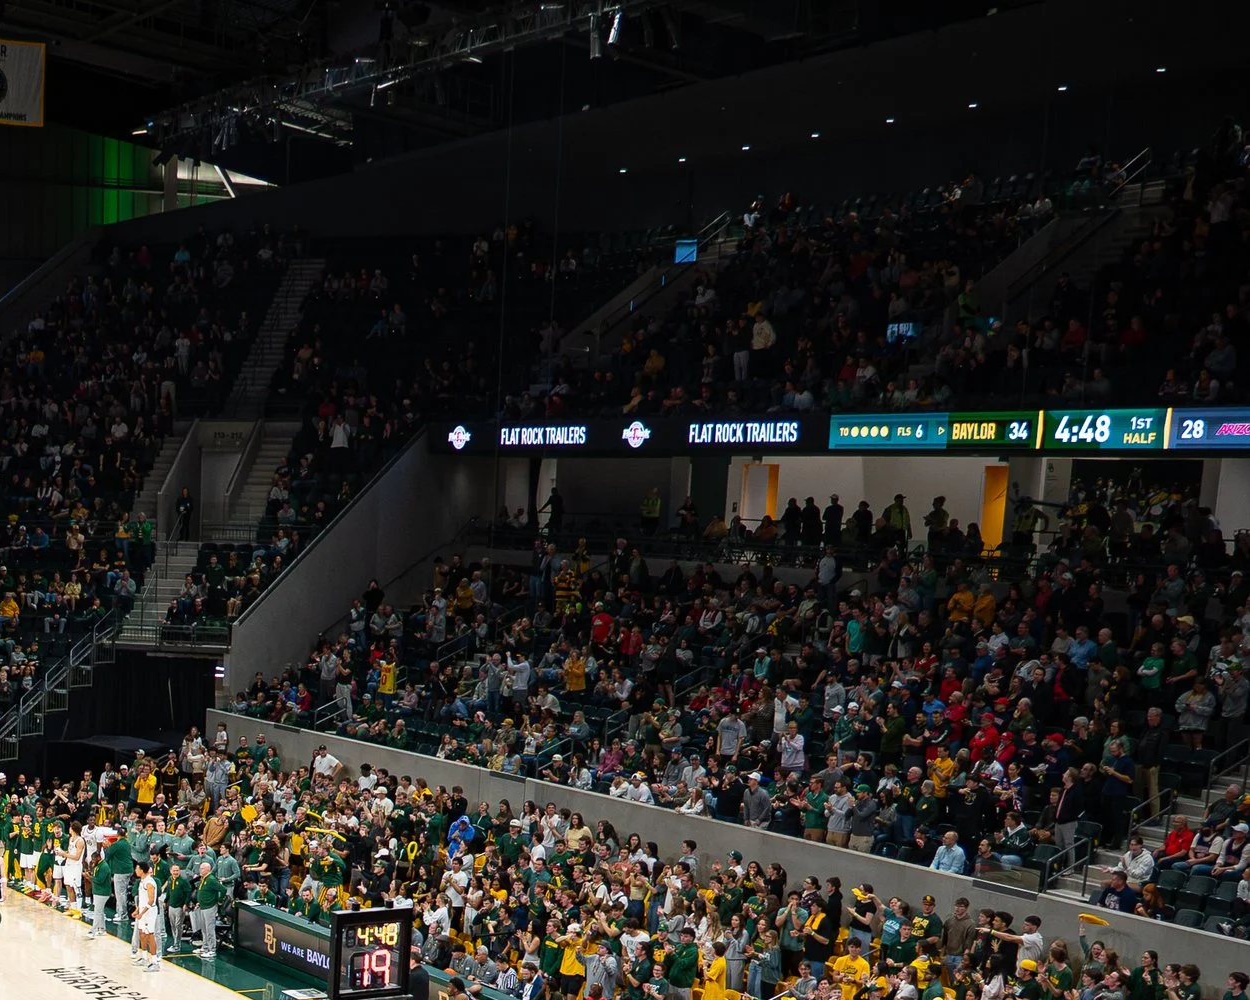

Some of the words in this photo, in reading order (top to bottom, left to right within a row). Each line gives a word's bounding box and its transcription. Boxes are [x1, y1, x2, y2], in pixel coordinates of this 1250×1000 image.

[689, 424, 714, 443] FLAT
[715, 423, 744, 443] ROCK
[746, 422, 798, 442] TRAILERS
[840, 427, 849, 436] TO
[897, 427, 911, 436] FLS
[915, 424, 923, 438] 6
[952, 423, 996, 439] BAYLOR
[1009, 422, 1028, 439] 34
[1054, 415, 1111, 443] 4:48
[1130, 416, 1154, 430] 1ST
[1181, 420, 1204, 439] 28
[500, 428, 520, 445] FLAT
[520, 427, 544, 444] ROCK
[545, 426, 586, 444] TRAILERS
[1123, 433, 1156, 444] HALF
[264, 923, 277, 954] BU
[357, 923, 398, 946] 4:48
[280, 941, 291, 953] WE
[292, 947, 304, 958] ARE
[70, 965, 118, 985] MARK
[363, 950, 391, 988] 19
[41, 967, 101, 991] HURD
